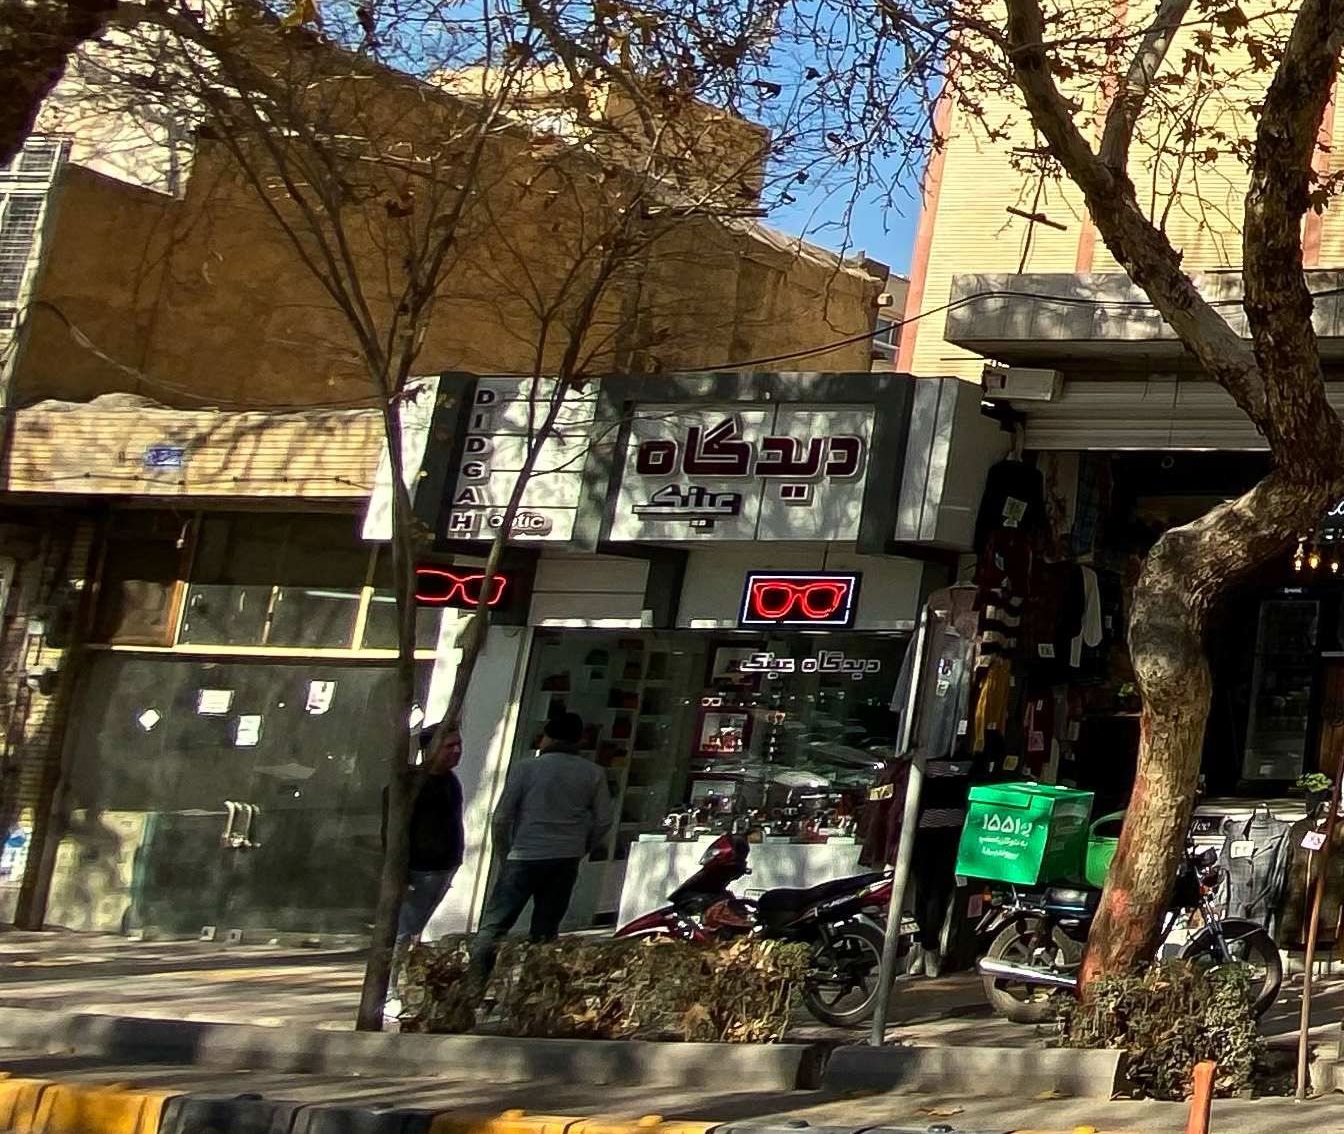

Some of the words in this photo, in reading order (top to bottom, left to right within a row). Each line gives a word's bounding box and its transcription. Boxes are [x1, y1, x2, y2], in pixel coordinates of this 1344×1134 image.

[449, 388, 496, 531] DIDGAH
[636, 415, 863, 502] دیدگاه
[488, 512, 546, 530] otic
[631, 483, 743, 528] عینک
